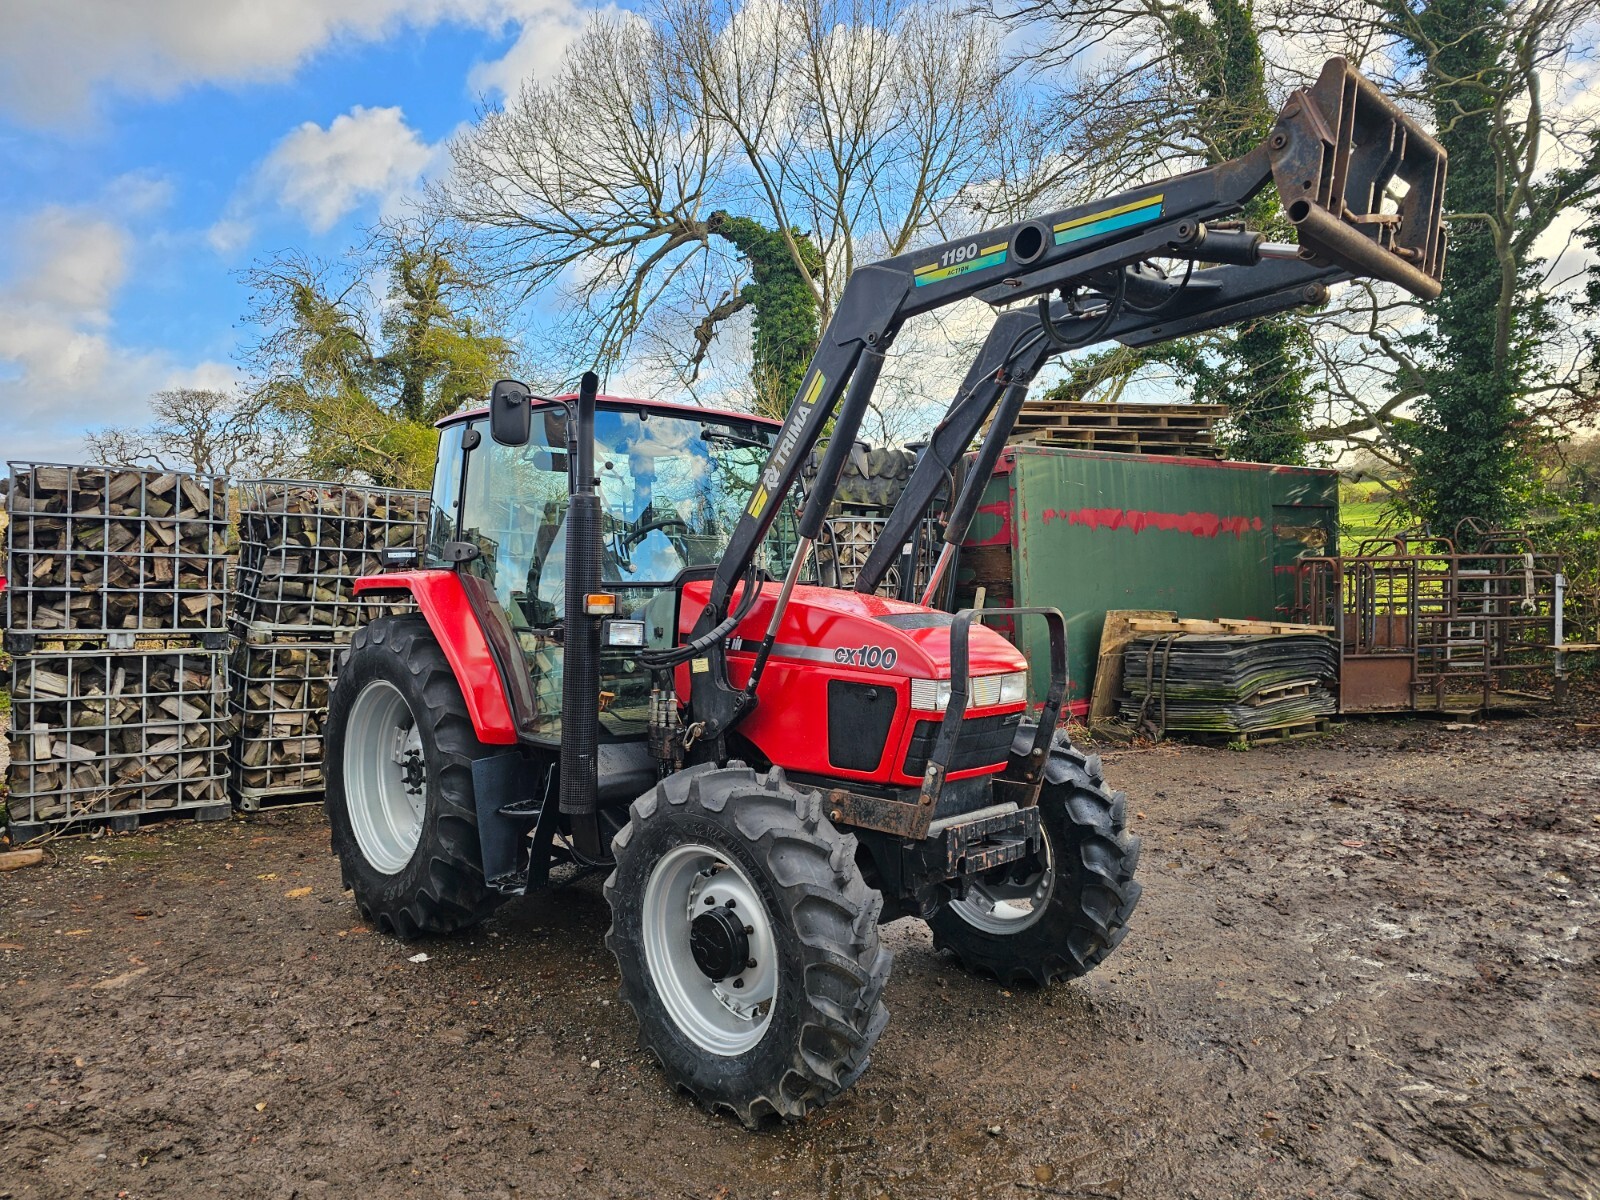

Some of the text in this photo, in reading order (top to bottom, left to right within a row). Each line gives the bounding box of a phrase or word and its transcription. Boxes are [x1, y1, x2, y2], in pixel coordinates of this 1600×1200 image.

[941, 242, 978, 267] 1190
[946, 265, 970, 277] ACTION
[773, 405, 812, 466] TRIMA
